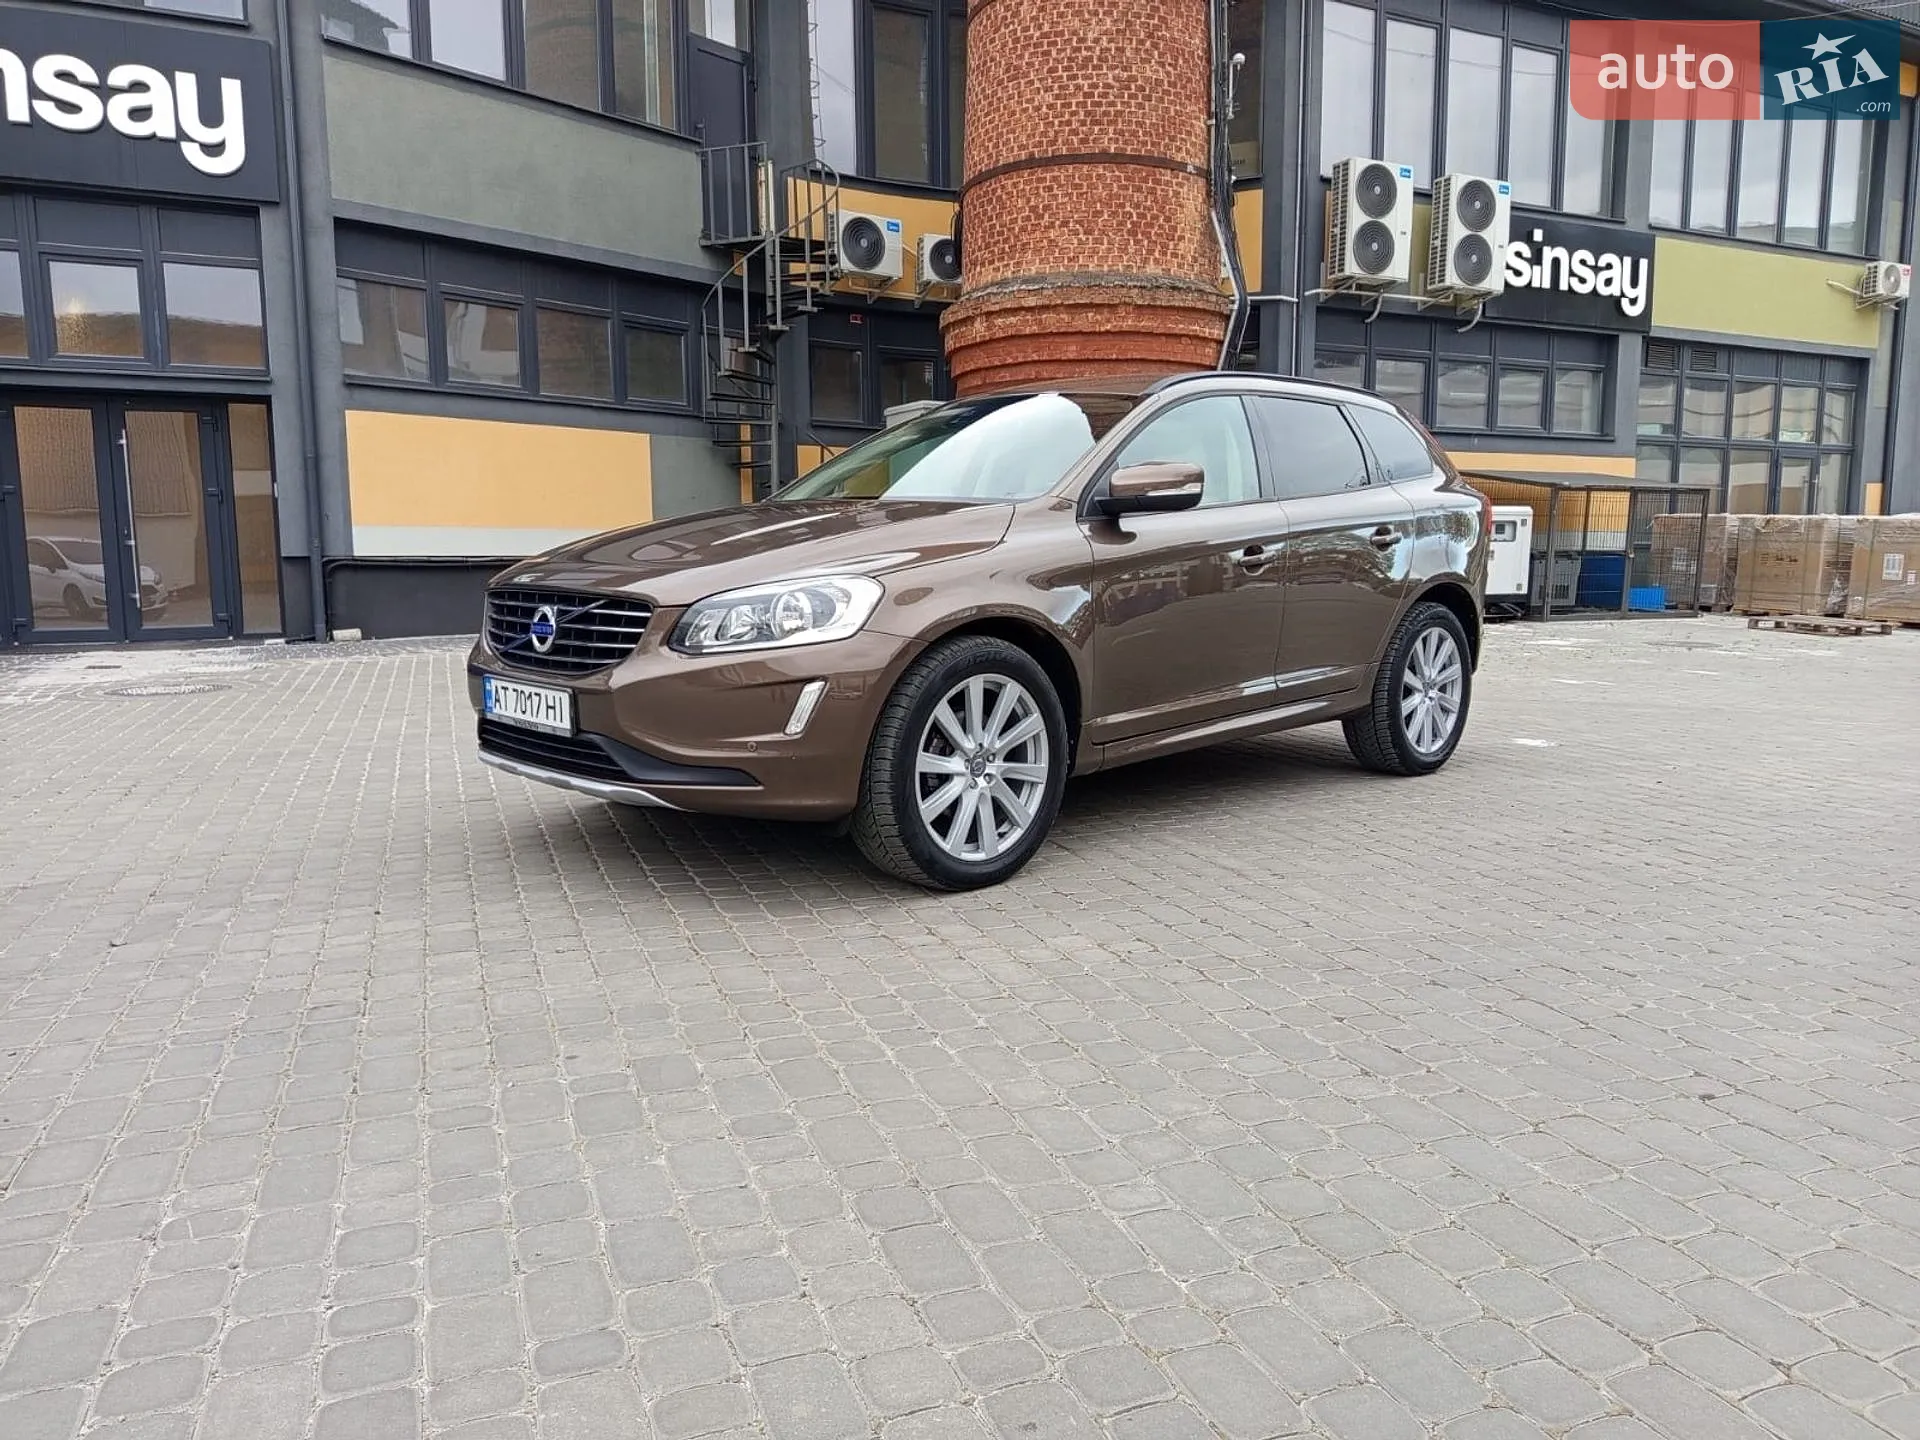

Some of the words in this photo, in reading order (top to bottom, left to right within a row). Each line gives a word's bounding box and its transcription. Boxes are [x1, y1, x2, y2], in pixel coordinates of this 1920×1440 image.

[1504, 228, 1648, 317] sinsay
[494, 685, 509, 711] AT
[512, 688, 541, 718] 7017
[545, 694, 563, 723] HI
